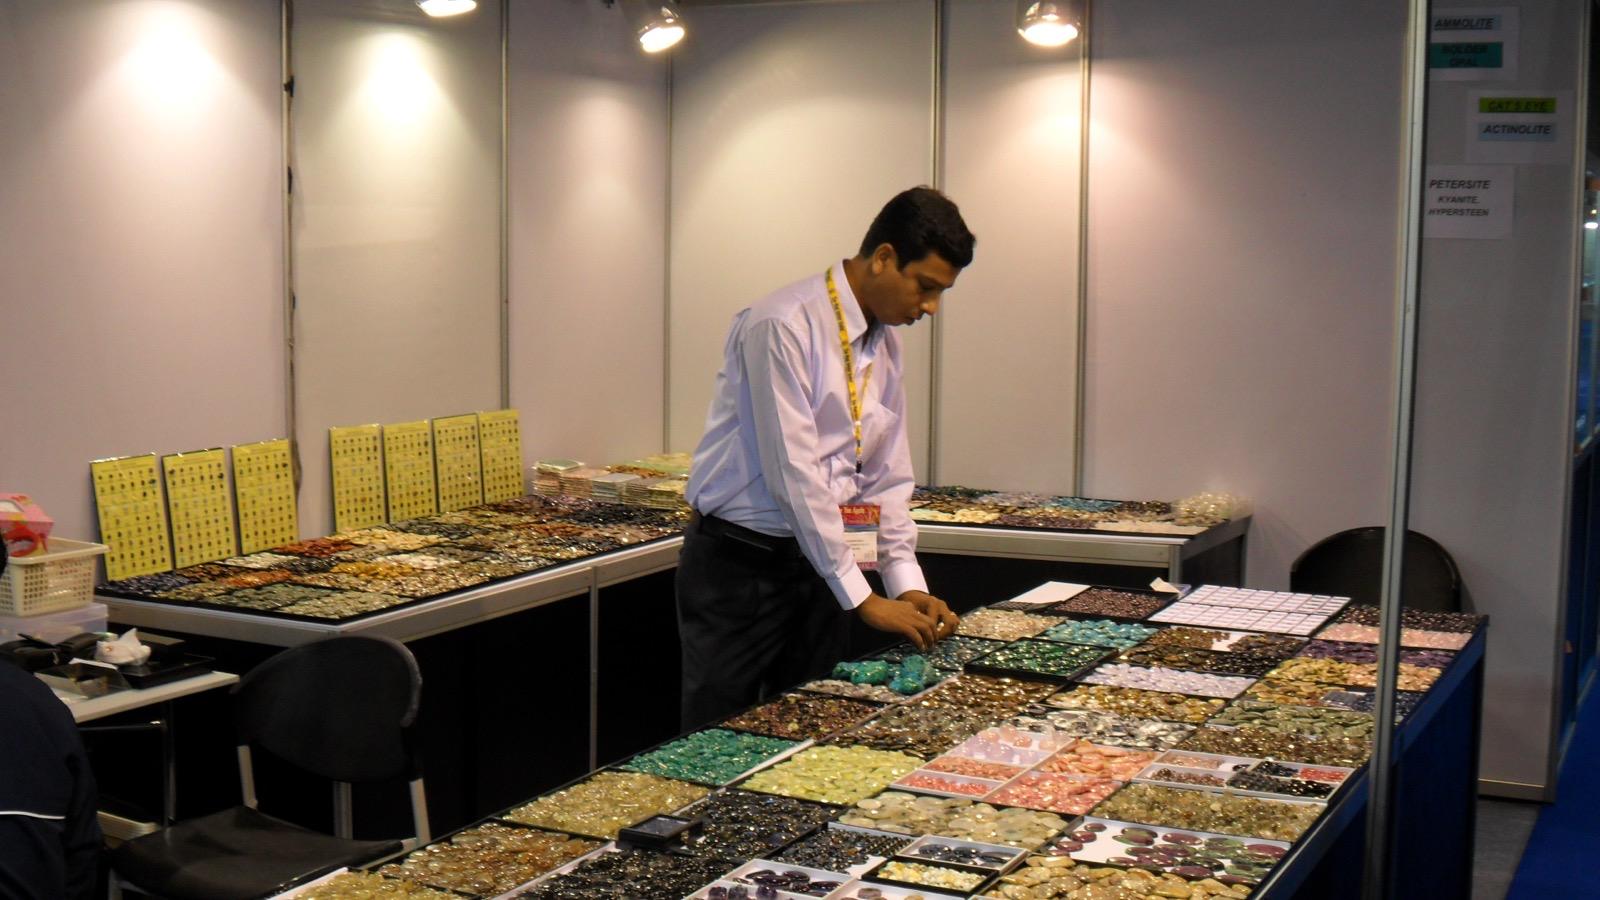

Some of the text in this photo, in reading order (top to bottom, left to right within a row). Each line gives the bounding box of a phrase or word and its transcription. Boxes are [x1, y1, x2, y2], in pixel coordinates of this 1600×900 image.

[1434, 18, 1494, 30] AMMOLITE
[1483, 124, 1551, 135] ACTINOLITE
[1429, 180, 1491, 189] PETERSITE
[1428, 208, 1489, 217] HYPERSTEEN
